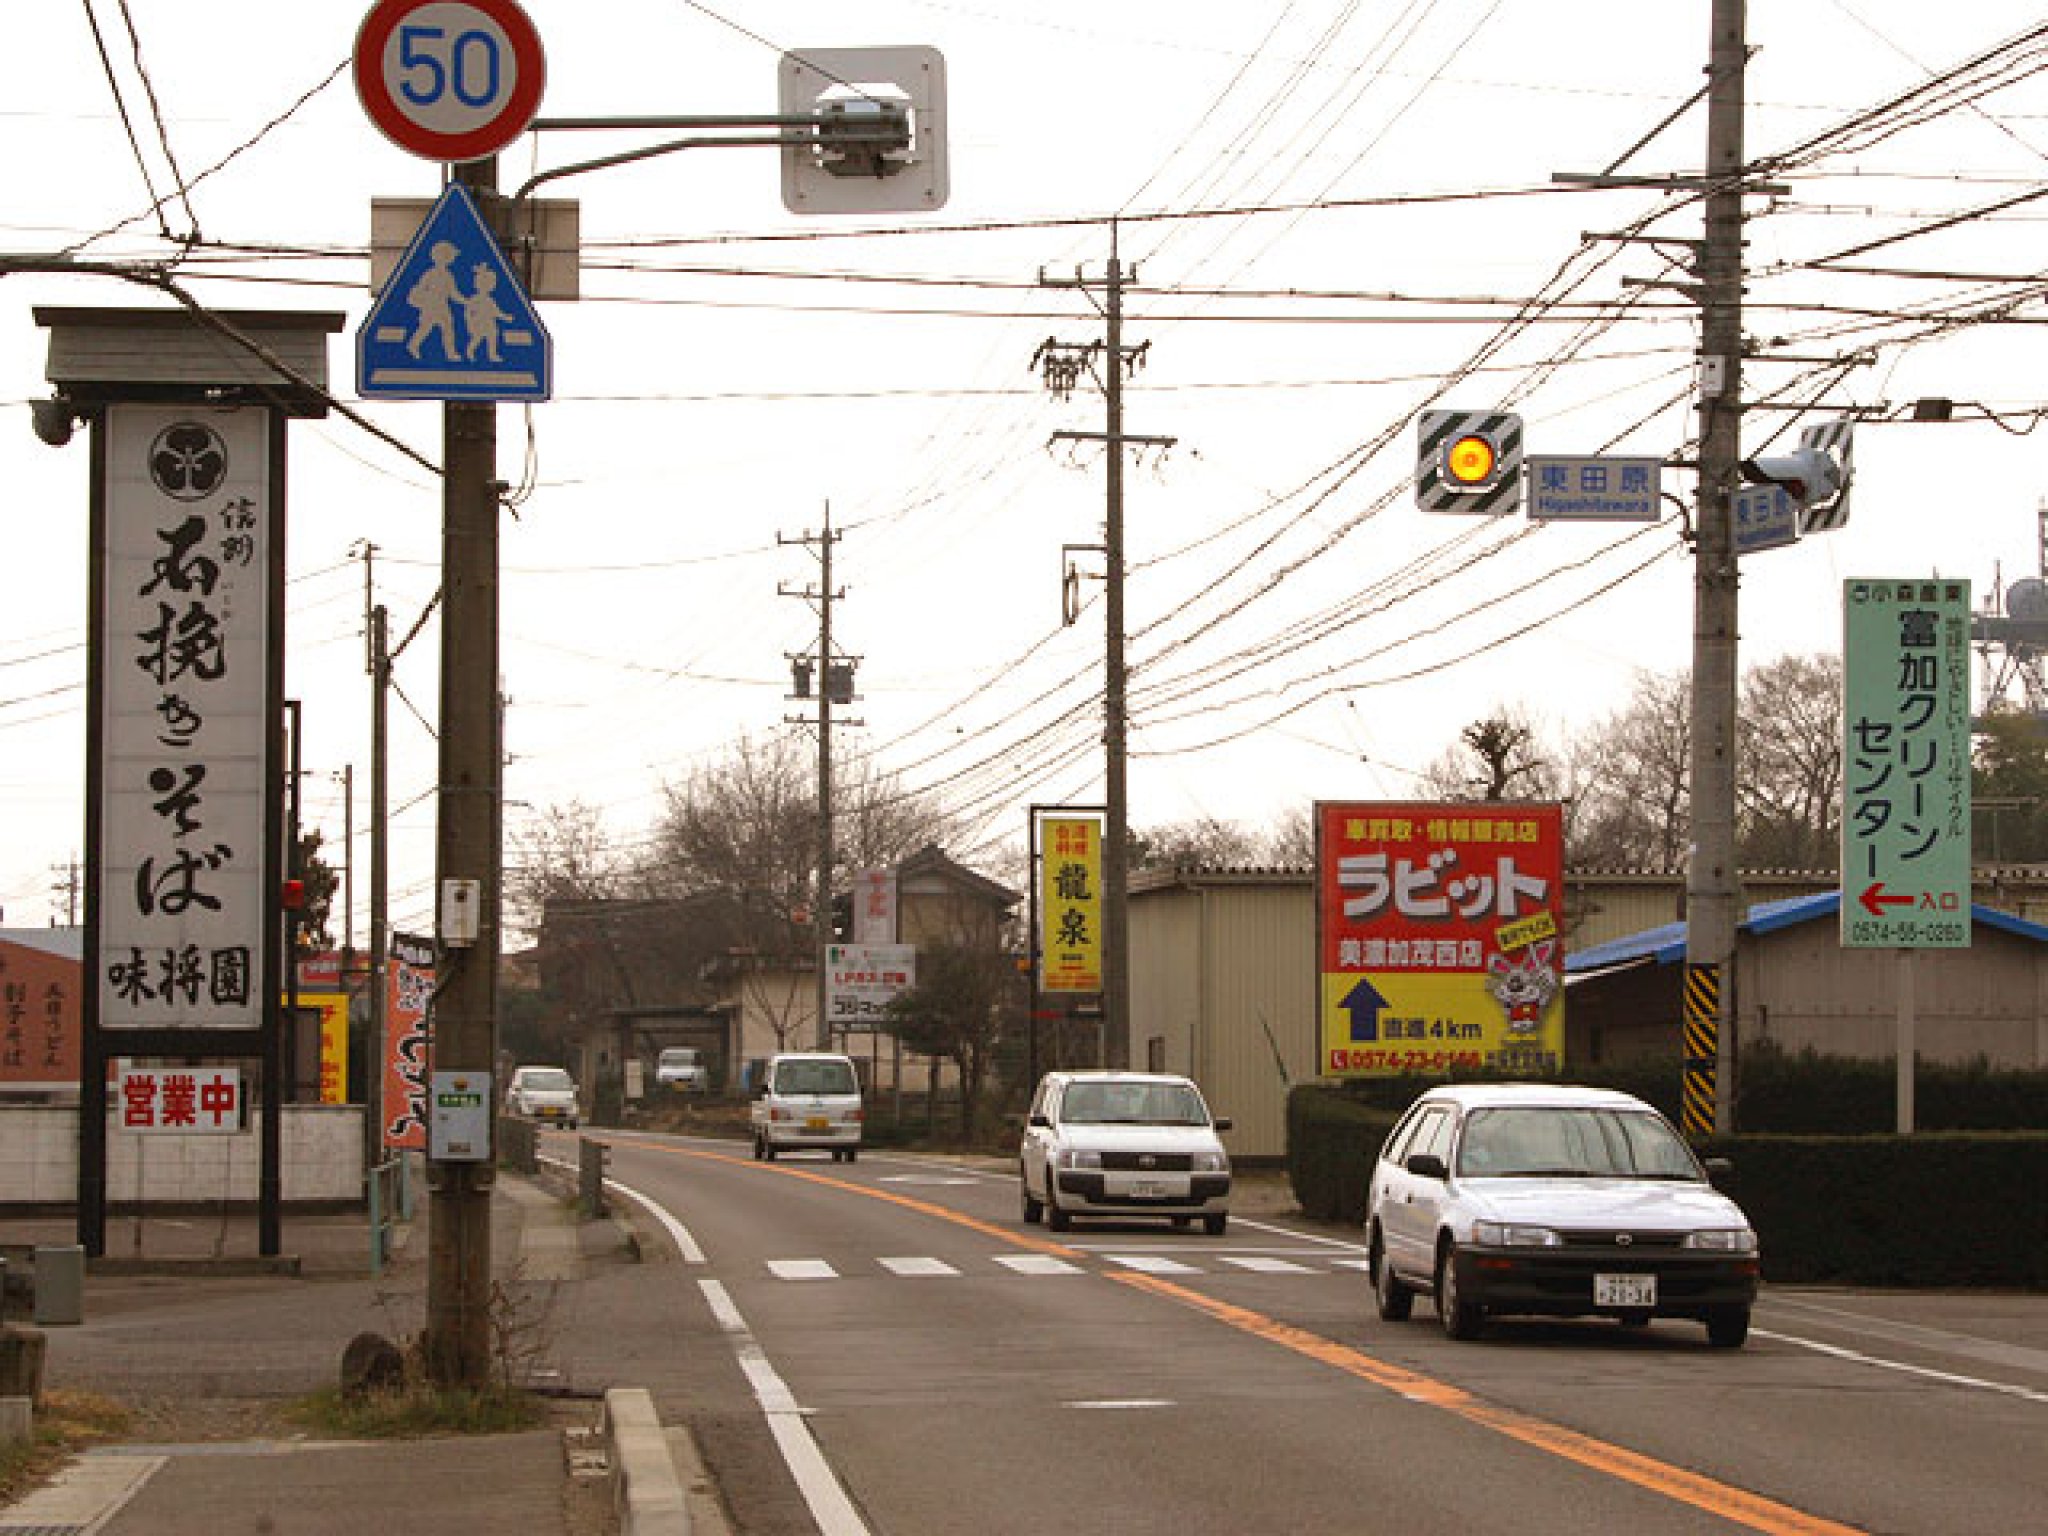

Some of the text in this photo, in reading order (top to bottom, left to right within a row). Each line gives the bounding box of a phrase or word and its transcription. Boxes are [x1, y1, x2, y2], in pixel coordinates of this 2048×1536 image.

[399, 26, 501, 107] 50
[1541, 465, 1649, 493] 東田原
[1897, 608, 1940, 861] 富加クリーン
[1852, 715, 1893, 878] センター
[1052, 863, 1092, 947] 龍泉
[1336, 847, 1549, 918] ラビット
[1919, 892, 1959, 911] 入口
[108, 943, 252, 1007] 味将園
[121, 1074, 236, 1127] 営業中
